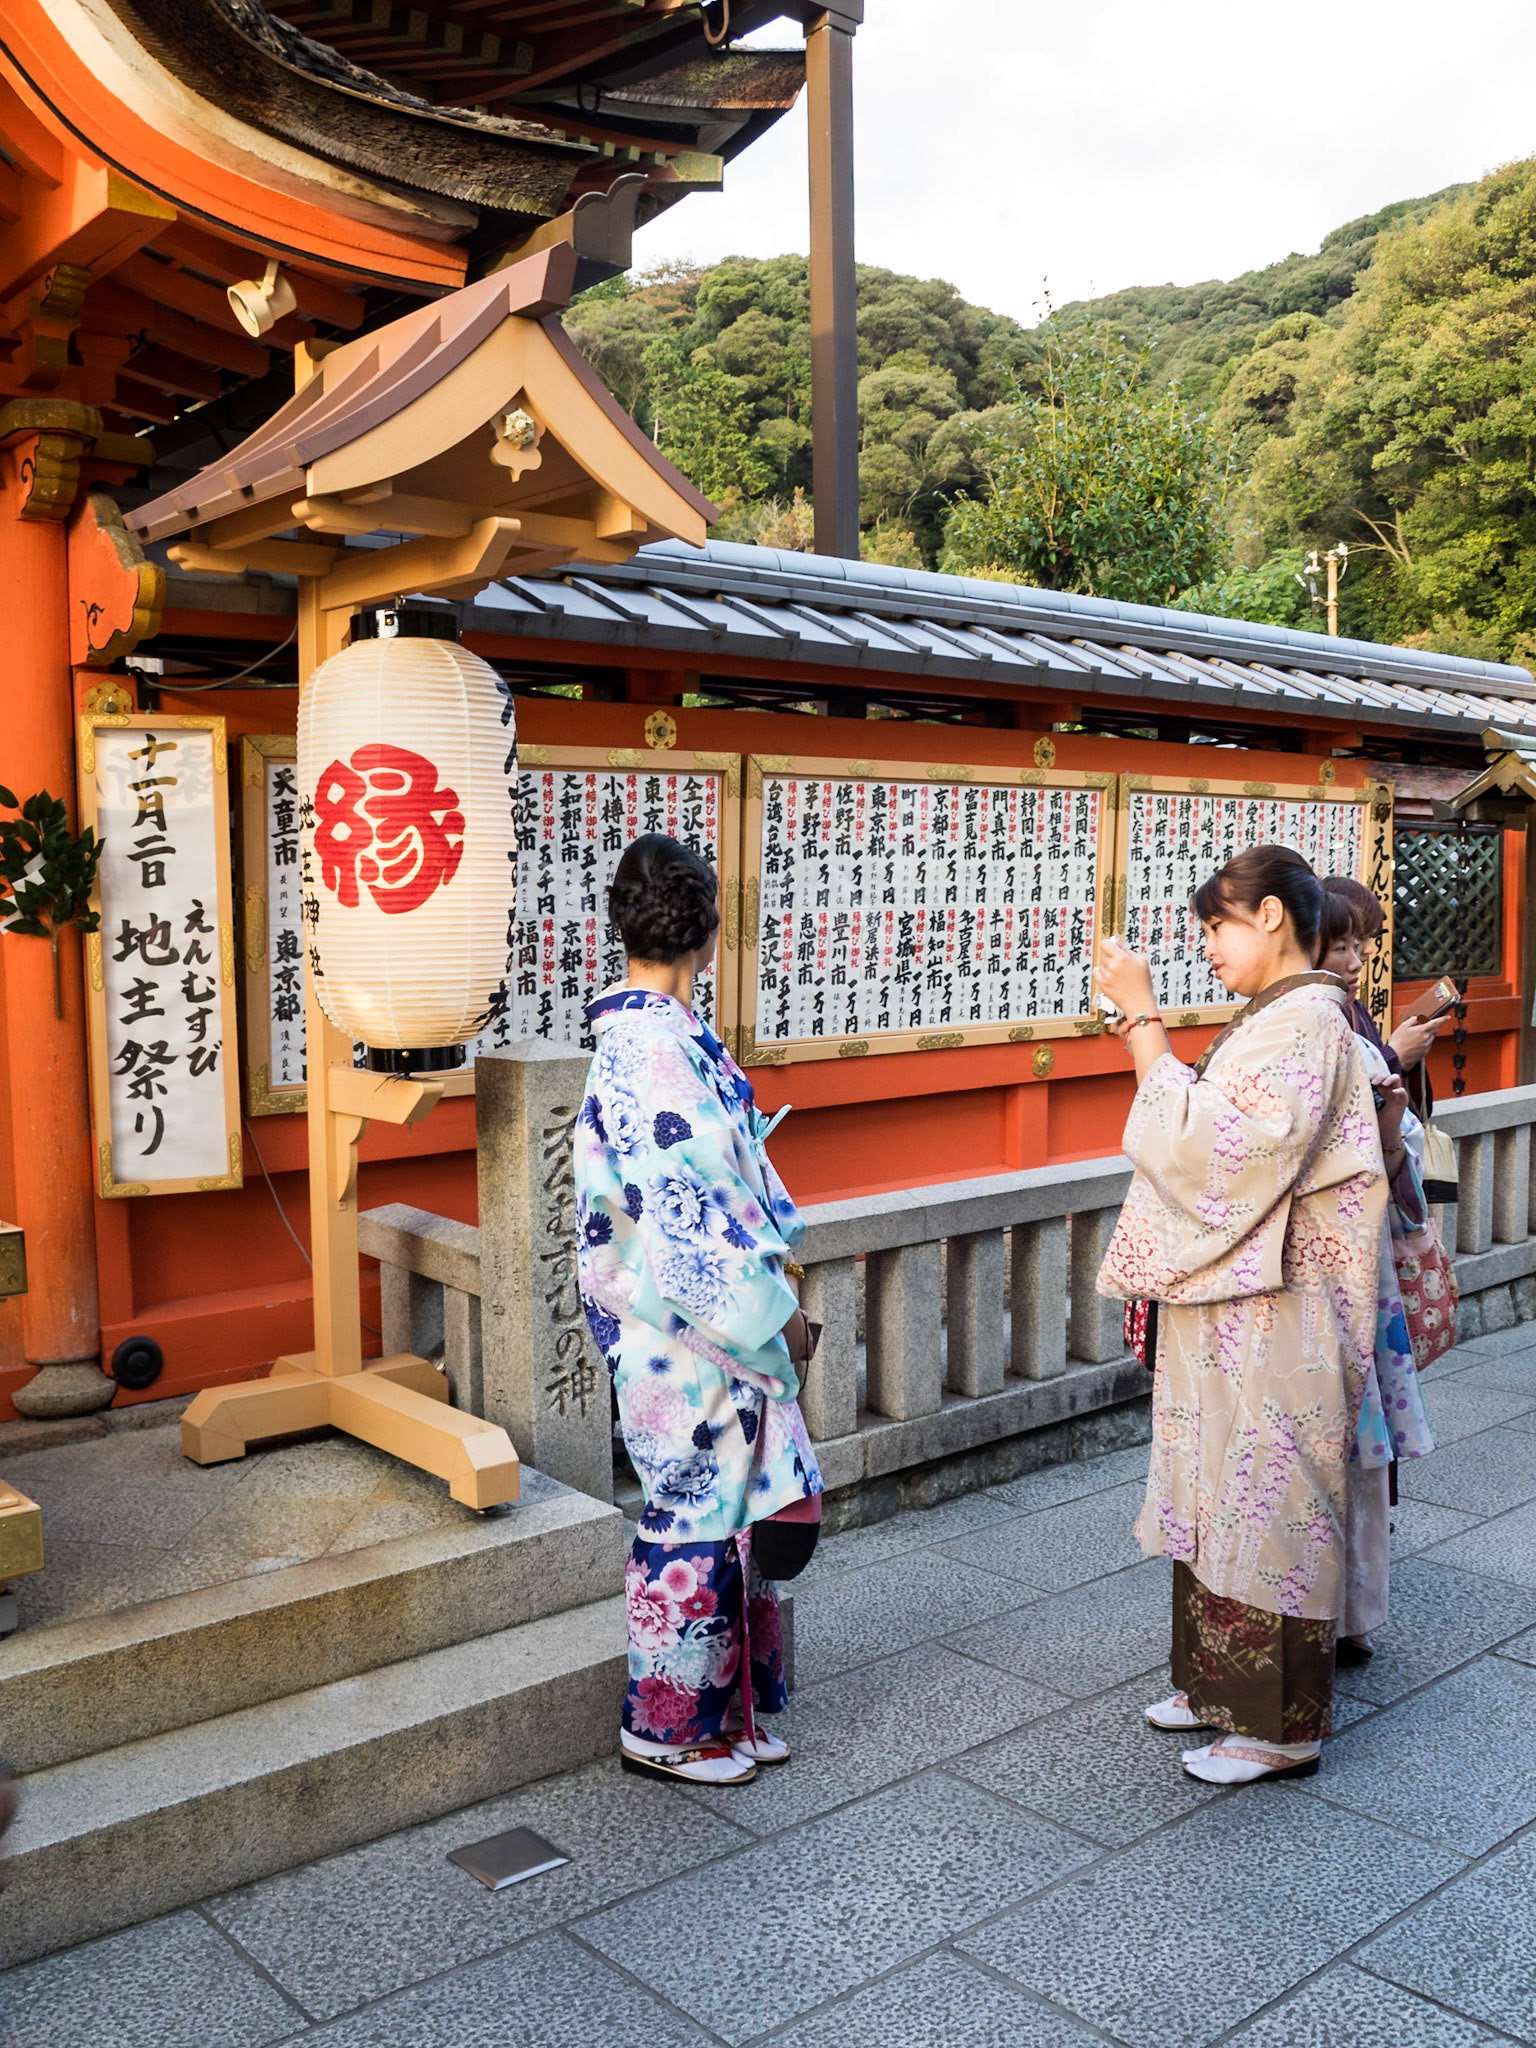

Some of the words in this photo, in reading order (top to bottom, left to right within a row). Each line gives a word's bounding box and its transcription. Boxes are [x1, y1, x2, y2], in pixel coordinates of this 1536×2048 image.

[314, 743, 466, 914] 縁
[542, 772, 555, 840] 縁結び御礼
[559, 774, 583, 862] 大和郡山市
[585, 773, 598, 840] 縁結び御礼
[600, 775, 625, 852] 小樽市
[626, 774, 637, 839] 縁結び御礼
[705, 777, 716, 840] 縁結び御礼
[765, 780, 783, 874] 台湾台北市
[835, 784, 855, 855] 佐野市
[866, 785, 887, 857] 東京都
[902, 788, 917, 856] 町田市
[931, 788, 949, 860] 京都市
[964, 788, 979, 860] 富士見市
[991, 790, 1008, 861] 門真市
[1020, 791, 1036, 857] 静岡市
[1047, 791, 1062, 860] 南相馬市
[1074, 793, 1088, 857] 高岡市
[1131, 795, 1144, 861] さいたま市
[1155, 798, 1168, 858] 別府市
[537, 844, 555, 915] 五千円
[580, 845, 597, 912] 五千円
[780, 847, 795, 909] 五千円
[816, 849, 830, 907] 一万円
[850, 850, 863, 907] 一万円
[883, 849, 895, 904] 一万円
[915, 849, 926, 904] 一万円
[946, 849, 957, 903] 一万円
[976, 851, 986, 903] 一万円
[1003, 852, 1015, 903] 一万円
[1031, 852, 1042, 902] 一万円
[1059, 850, 1070, 901] 一万円
[1085, 853, 1095, 902] 一万円
[1141, 855, 1151, 900] 一万円
[1164, 851, 1174, 898] 一万円
[515, 920, 540, 996] 福岡市
[542, 918, 555, 985] 縁結び御礼
[557, 920, 583, 999] 京都市
[585, 917, 597, 983] 縁結び御礼
[760, 914, 781, 990] 金沢市
[797, 912, 816, 985] 恵那市
[831, 912, 850, 985] 豊川市
[865, 911, 881, 980] 新居浜市
[895, 911, 915, 985] 宮城県
[927, 910, 945, 989] 福知山市
[957, 909, 975, 977] 名古屋市
[988, 909, 1004, 974] 半田市
[1017, 908, 1031, 971] 可児市
[1043, 908, 1059, 973] 飯田市
[1067, 907, 1085, 965] 大阪府
[1149, 905, 1162, 966] 京都市
[180, 898, 222, 1077] えんむすび
[272, 929, 303, 1022] 東京都
[776, 976, 790, 1038] 五千円
[812, 977, 825, 1035] 一万円
[845, 980, 858, 1034] 一万円
[878, 975, 890, 1028] 一万円
[910, 972, 922, 1027] 一万円
[940, 973, 952, 1022] 一万円
[970, 969, 981, 1020] 一万円
[999, 967, 1011, 1019] 一万円
[1027, 966, 1038, 1017] 一万円
[1054, 966, 1064, 1014] 一万円
[1079, 964, 1090, 1014] 一万円
[1160, 959, 1169, 1005] 一万円
[1182, 960, 1192, 1005] 一万円
[112, 912, 180, 1156] 地主祭り
